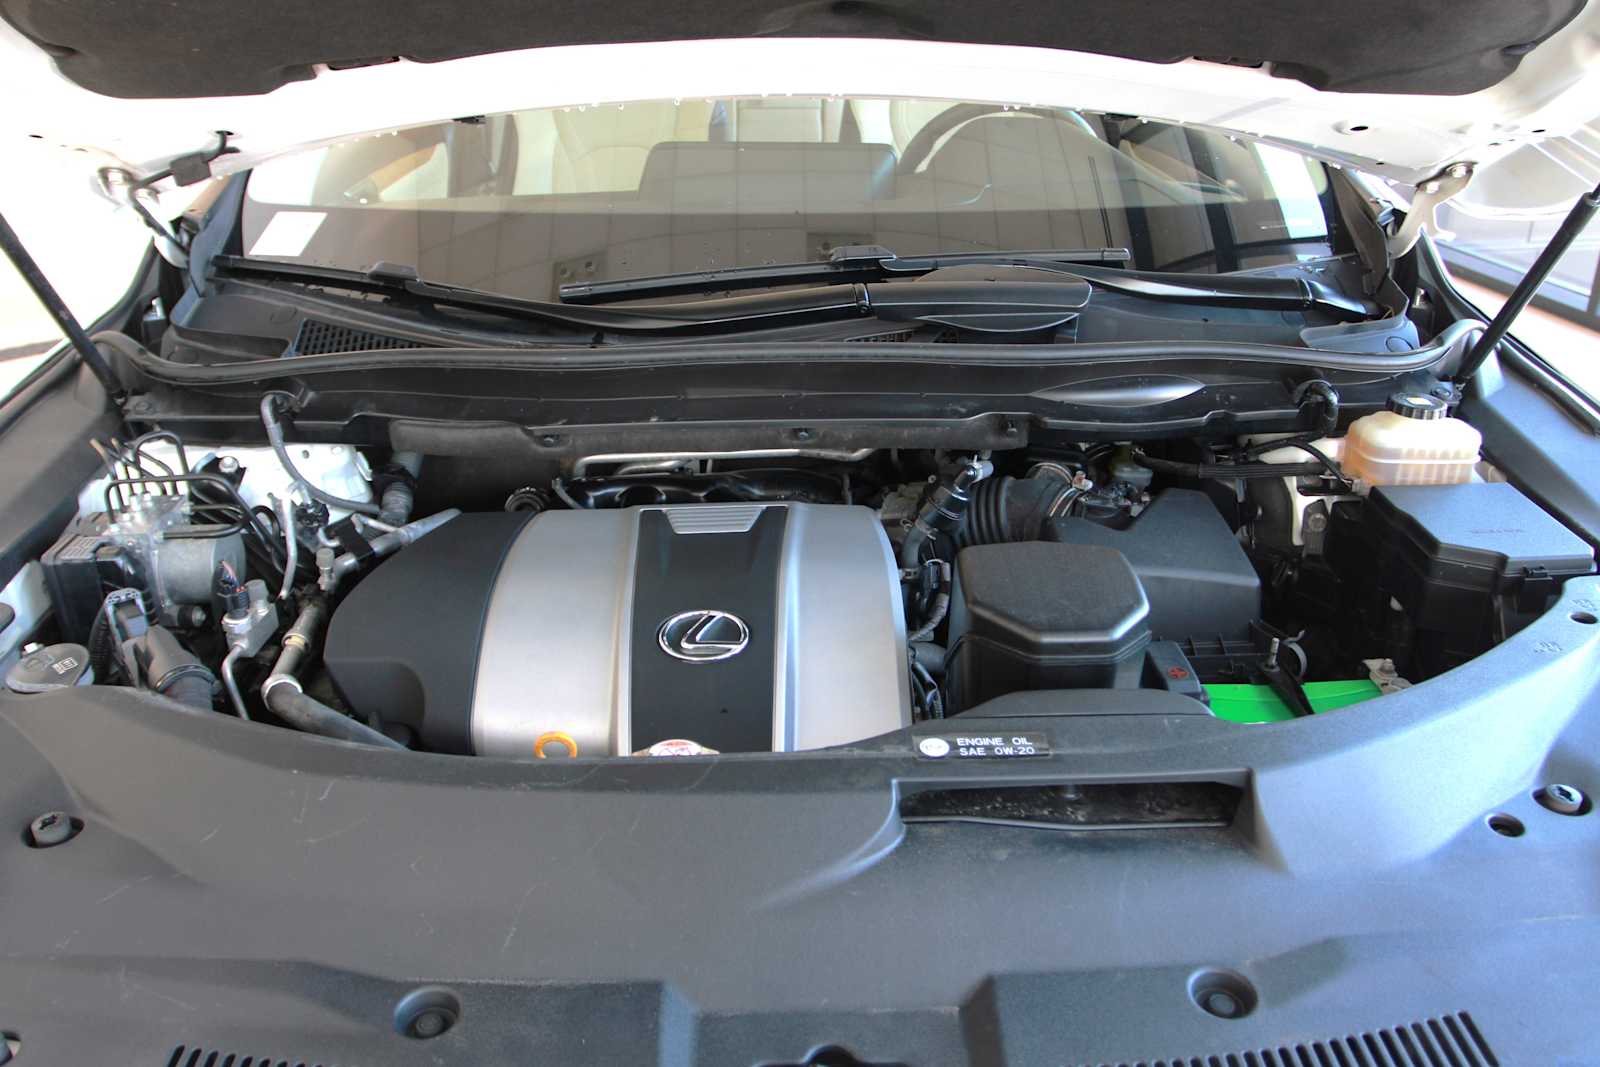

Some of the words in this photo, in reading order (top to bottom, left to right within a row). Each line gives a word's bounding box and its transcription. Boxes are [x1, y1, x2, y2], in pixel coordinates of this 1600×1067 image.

[956, 737, 1004, 746] ENGINE
[1012, 737, 1032, 745] OIL
[960, 747, 986, 756] SAE
[994, 747, 1035, 755] 0W-20
